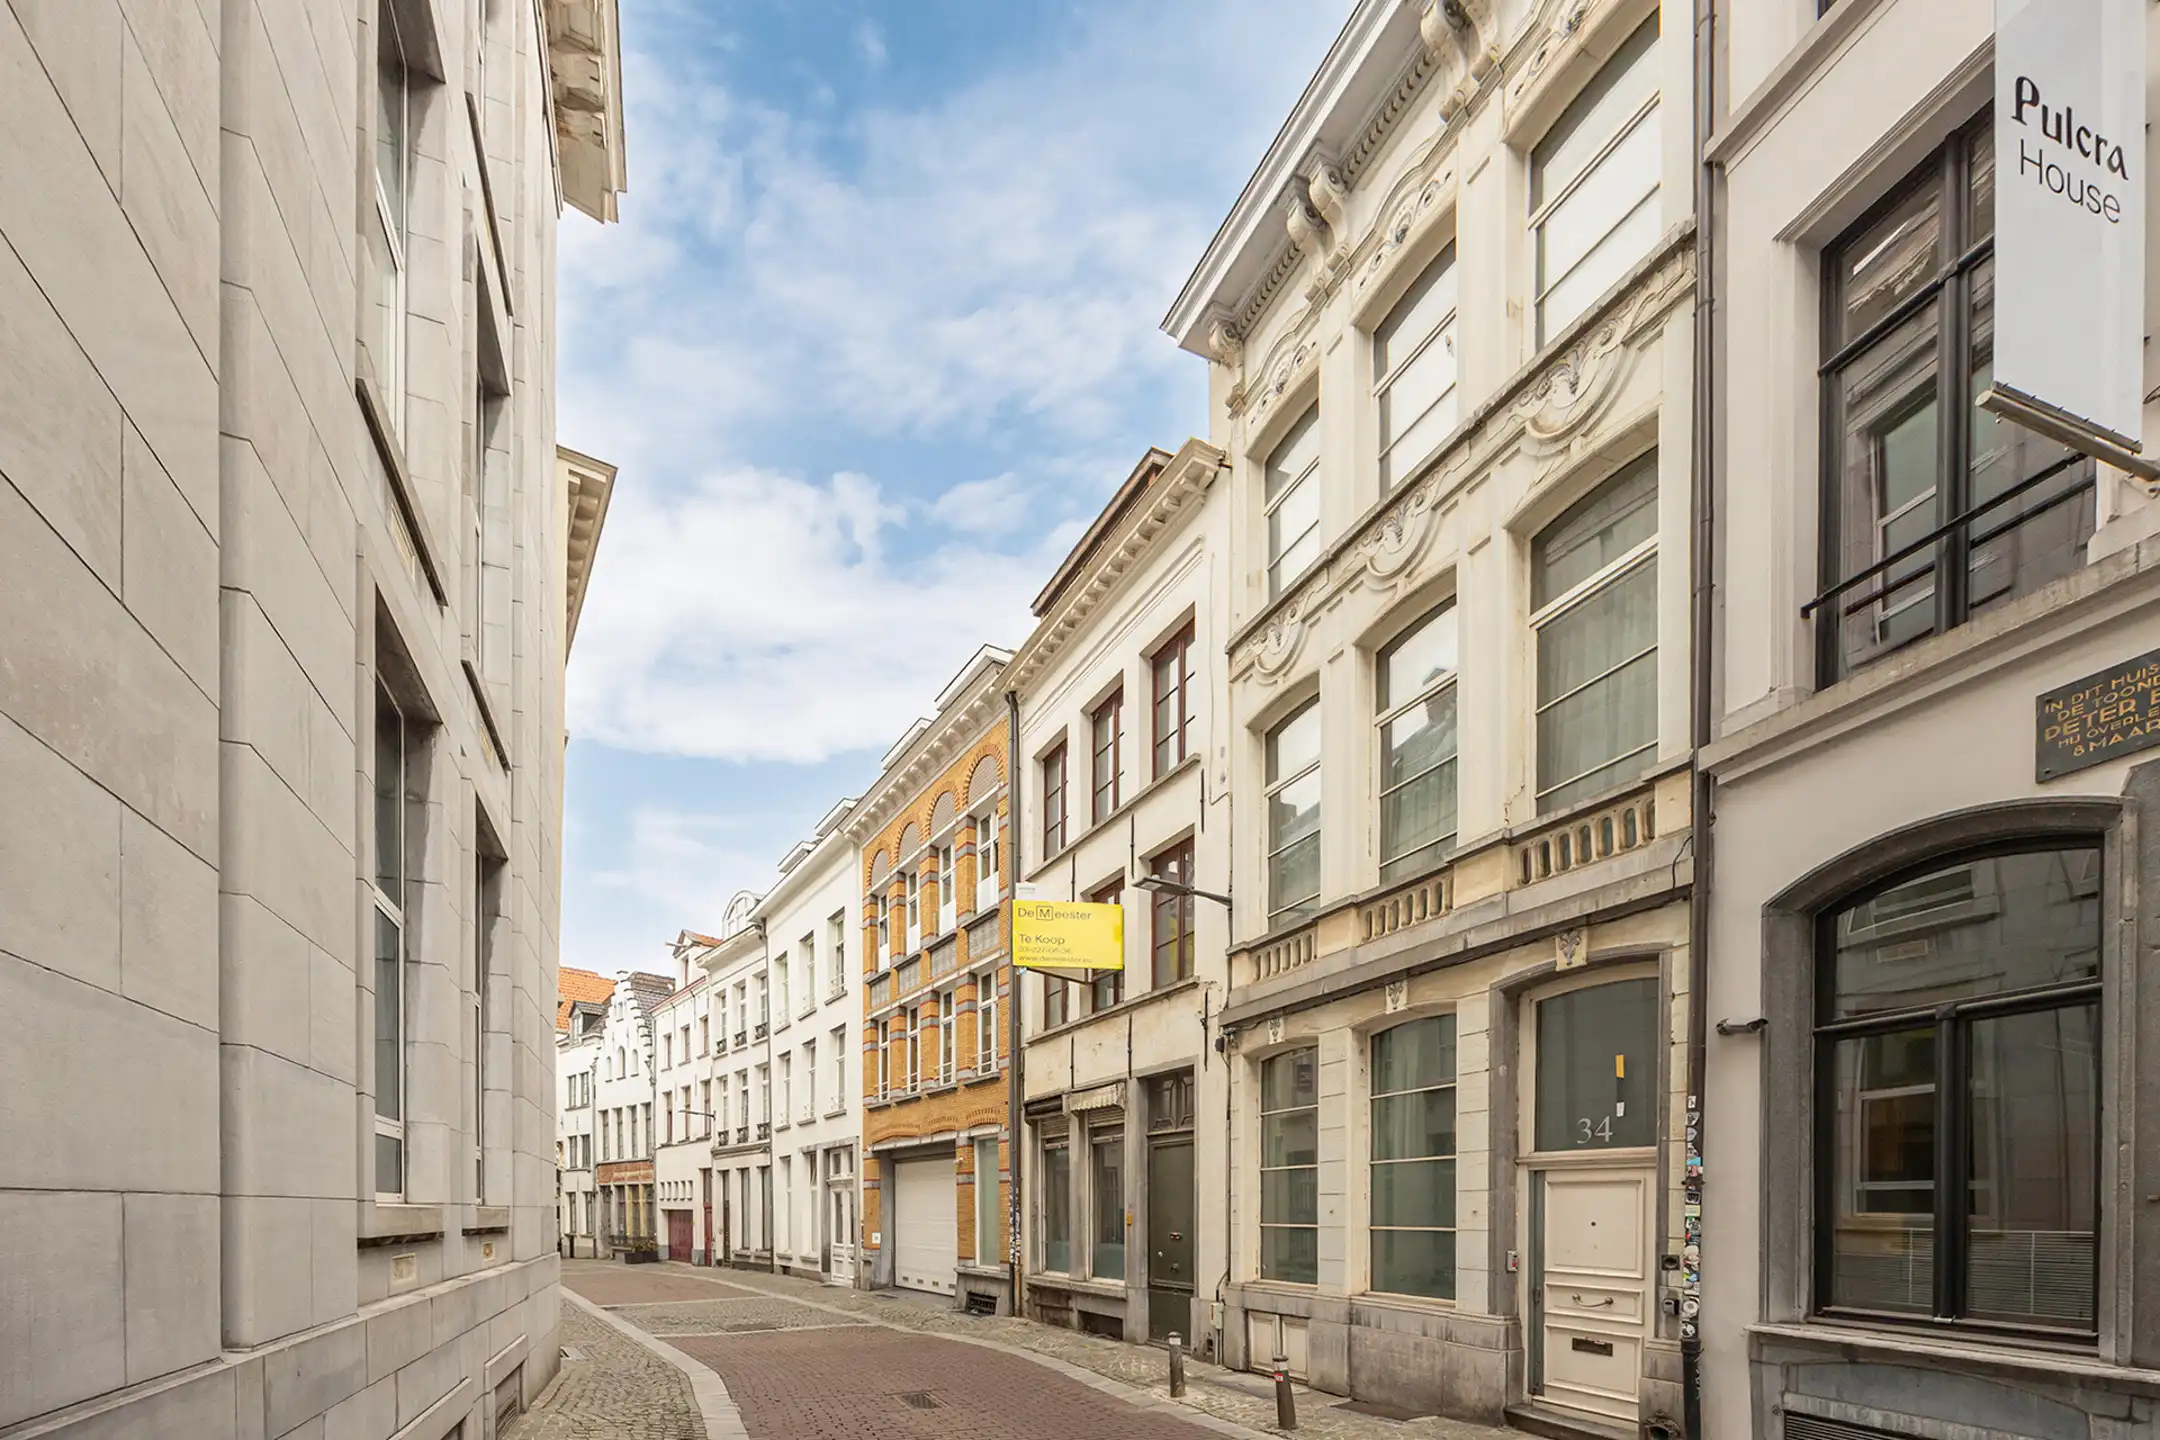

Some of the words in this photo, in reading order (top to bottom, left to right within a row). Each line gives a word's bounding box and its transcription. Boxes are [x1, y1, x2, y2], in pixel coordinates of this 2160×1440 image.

[2011, 75, 2129, 181] Pulcra
[2020, 138, 2121, 224] House
[2045, 700, 2064, 714] IN
[2071, 684, 2104, 705] DIT
[2057, 703, 2085, 721] DE
[1019, 933, 1032, 944] Te
[1035, 934, 1066, 946] Koop
[1576, 1115, 1614, 1144] 34
